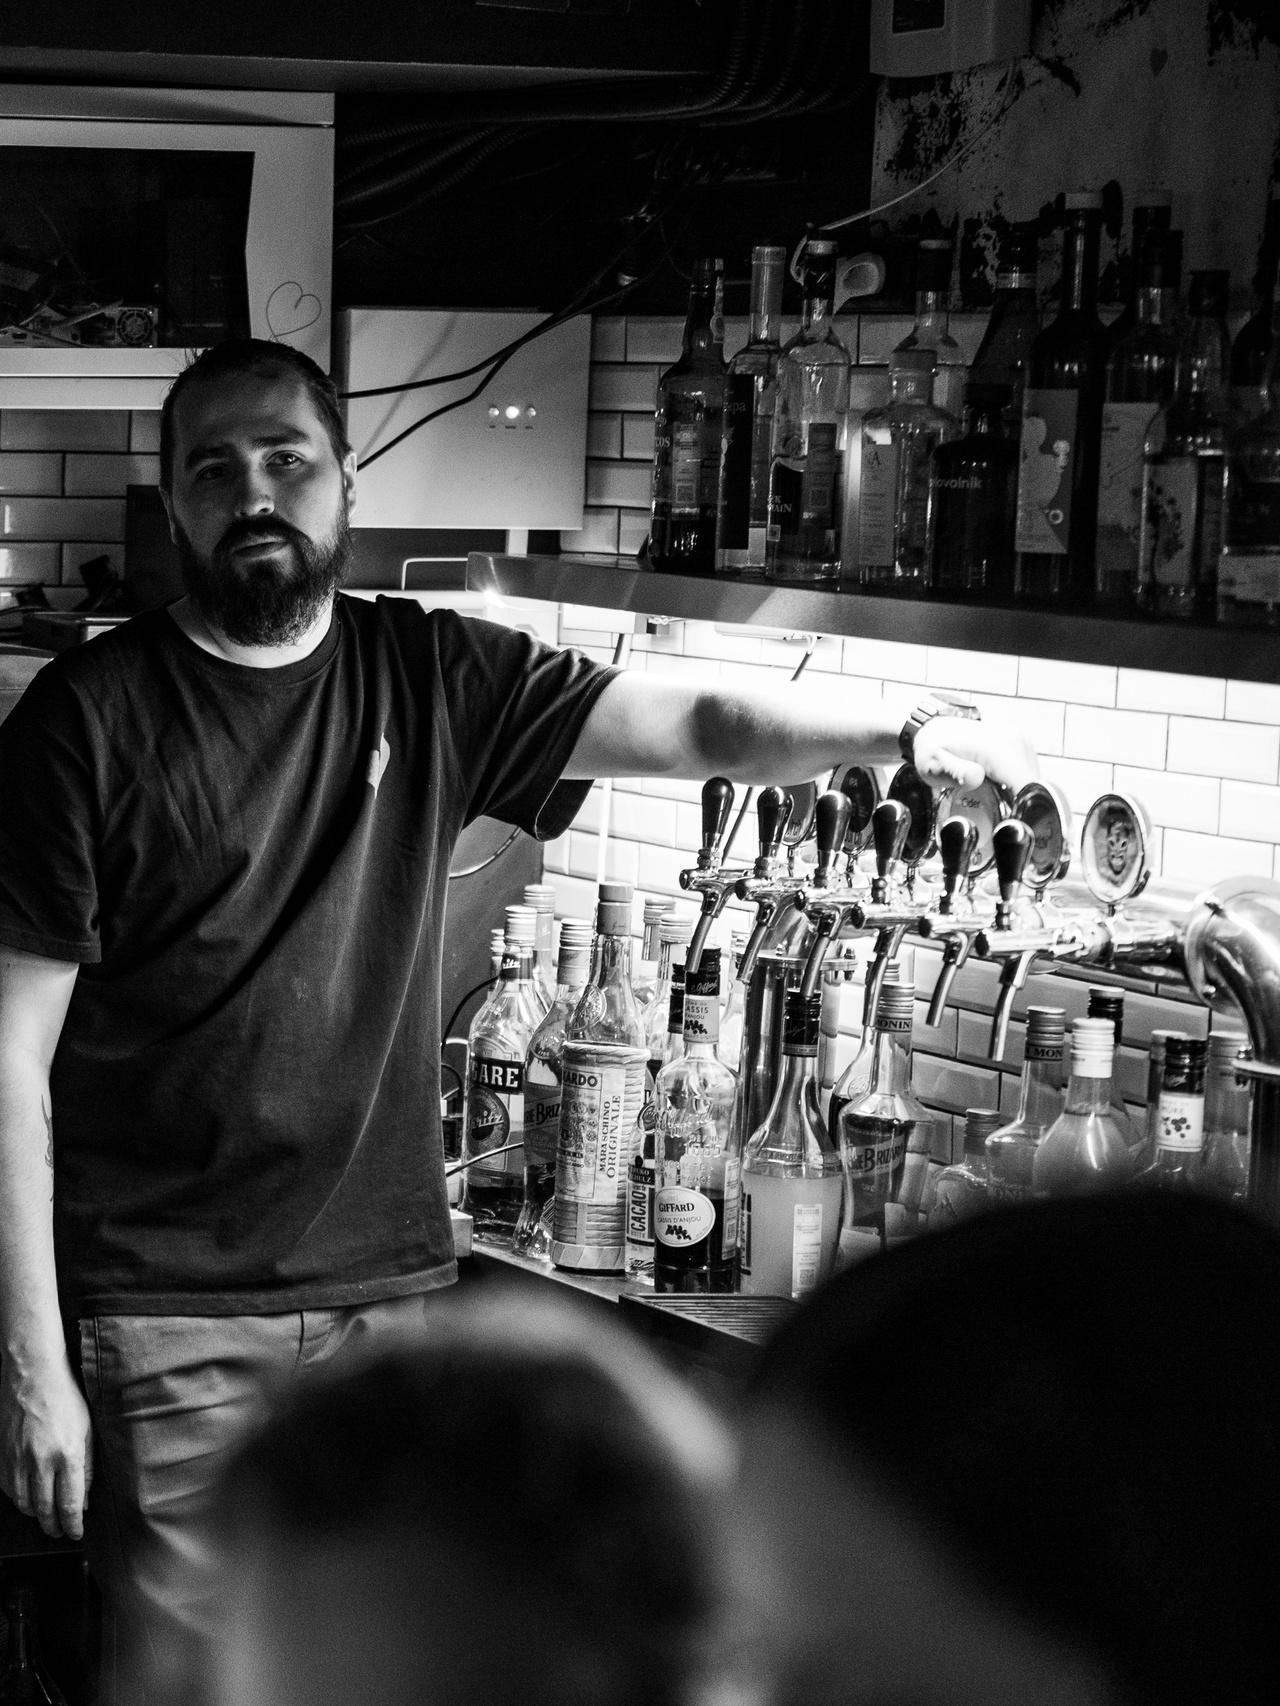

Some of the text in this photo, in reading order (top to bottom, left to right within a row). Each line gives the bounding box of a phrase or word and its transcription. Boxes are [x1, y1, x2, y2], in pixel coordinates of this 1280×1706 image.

[685, 1006, 709, 1014] ASSIS
[599, 1100, 611, 1172] MARASCHINO
[606, 1095, 621, 1179] ORIGINALE
[631, 1190, 647, 1232] CACAO
[658, 1202, 695, 1213] GIFFARD
